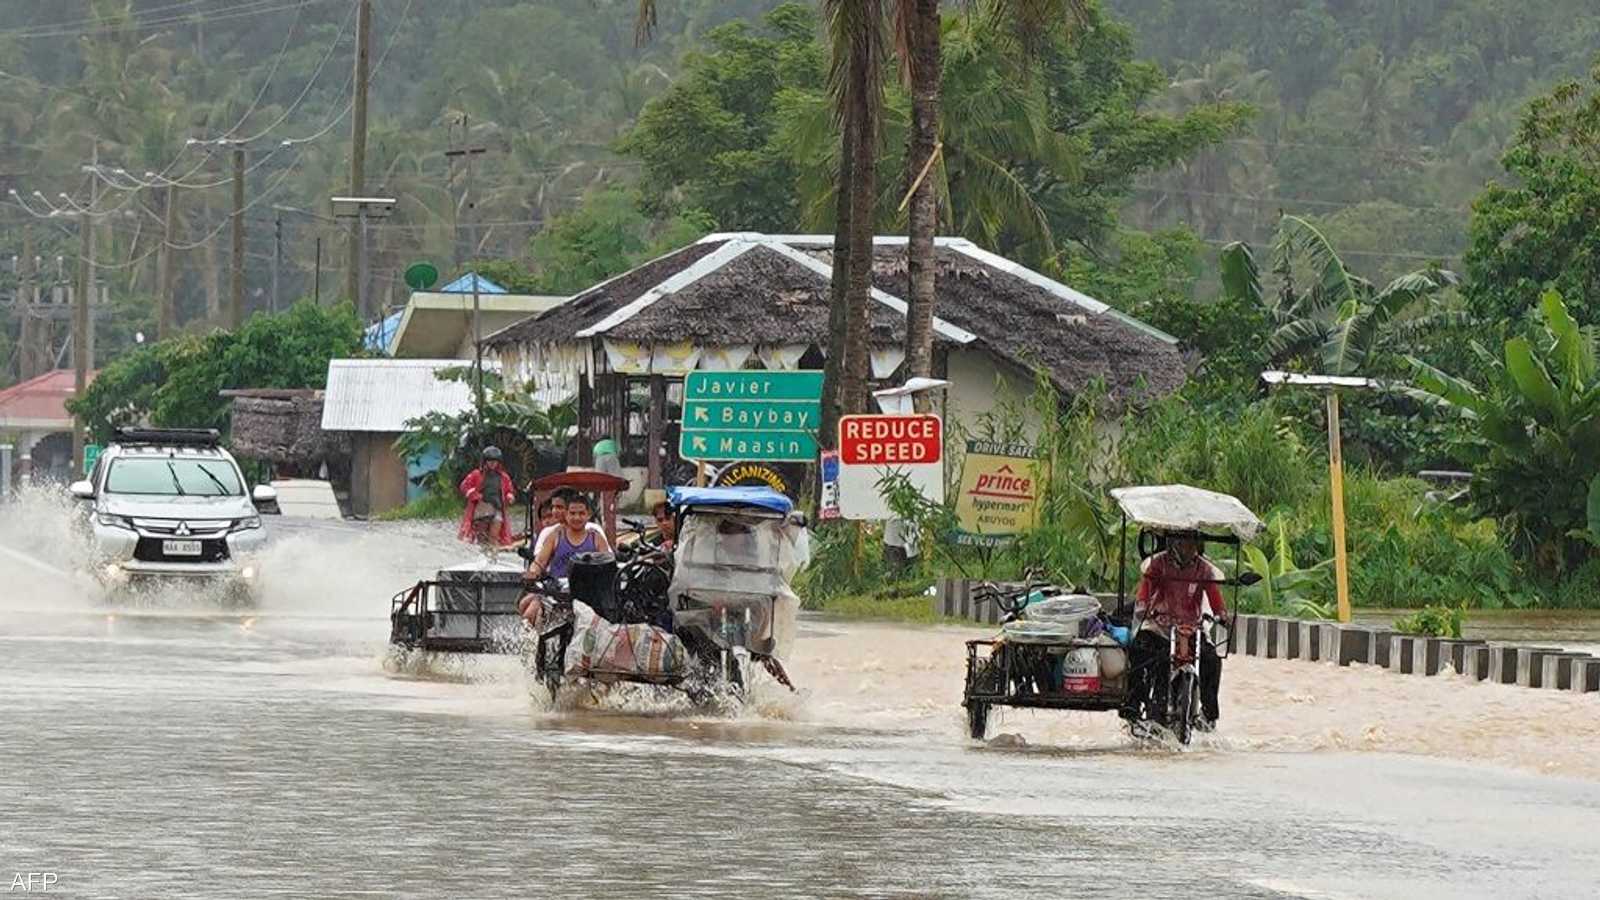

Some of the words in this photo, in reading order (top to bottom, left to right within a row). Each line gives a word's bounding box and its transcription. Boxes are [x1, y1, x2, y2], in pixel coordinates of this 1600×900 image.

[696, 377, 771, 394] Javier
[722, 406, 808, 428] Baybay
[847, 420, 934, 439] REDUCE
[720, 437, 799, 454] Maasin
[856, 442, 926, 460] SPEED
[974, 441, 1006, 455] DRIVE
[720, 464, 786, 493] ULCANIZING
[975, 472, 1031, 493] prince
[973, 497, 1025, 512] hypermart
